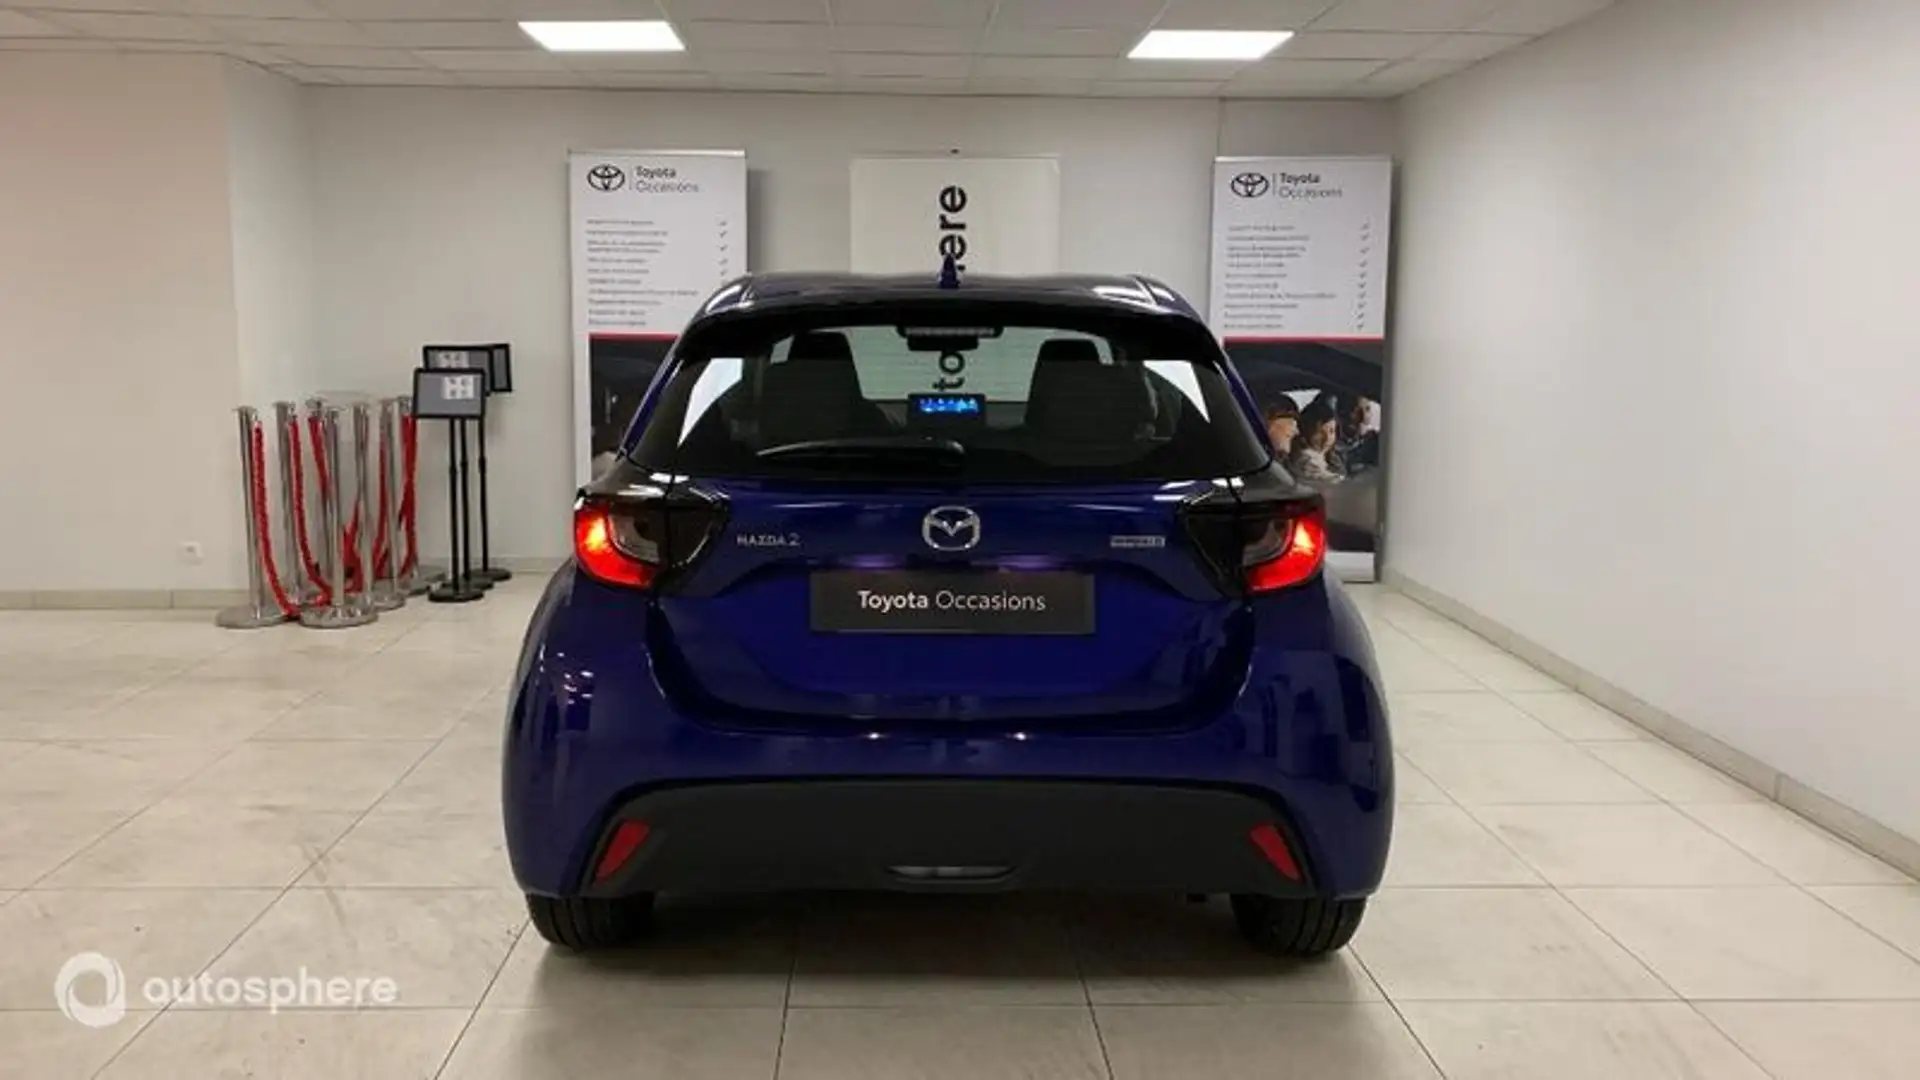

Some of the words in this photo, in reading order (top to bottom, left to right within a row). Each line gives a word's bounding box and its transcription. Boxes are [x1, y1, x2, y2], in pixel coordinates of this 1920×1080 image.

[635, 165, 677, 179] Toyota
[1279, 172, 1320, 186] Toyota
[856, 589, 929, 613] Toyota
[935, 589, 1047, 612] Occasions
